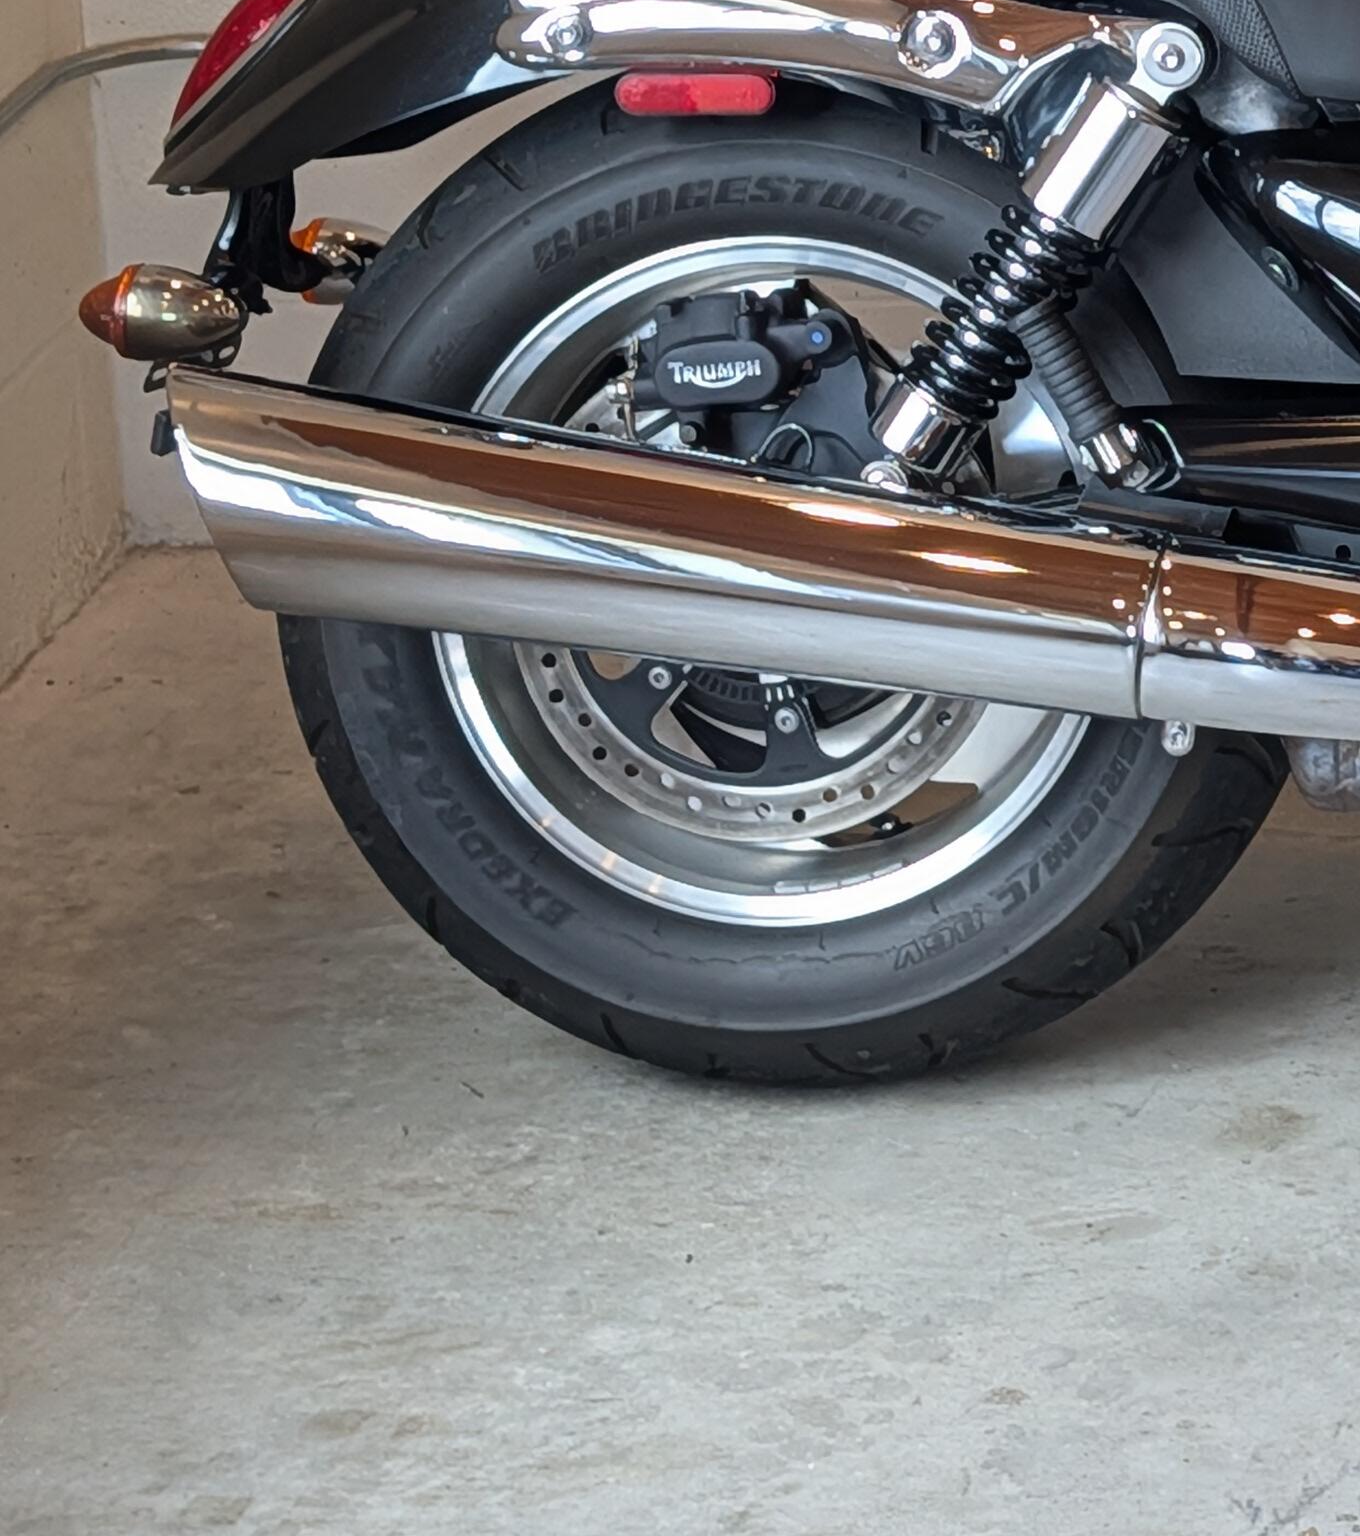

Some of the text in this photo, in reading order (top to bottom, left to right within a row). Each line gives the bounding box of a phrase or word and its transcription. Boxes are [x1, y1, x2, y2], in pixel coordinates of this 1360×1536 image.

[532, 175, 945, 274] BRIDGESTONE
[667, 359, 761, 389] TRIUMPH
[415, 766, 579, 928] EXEDRA
